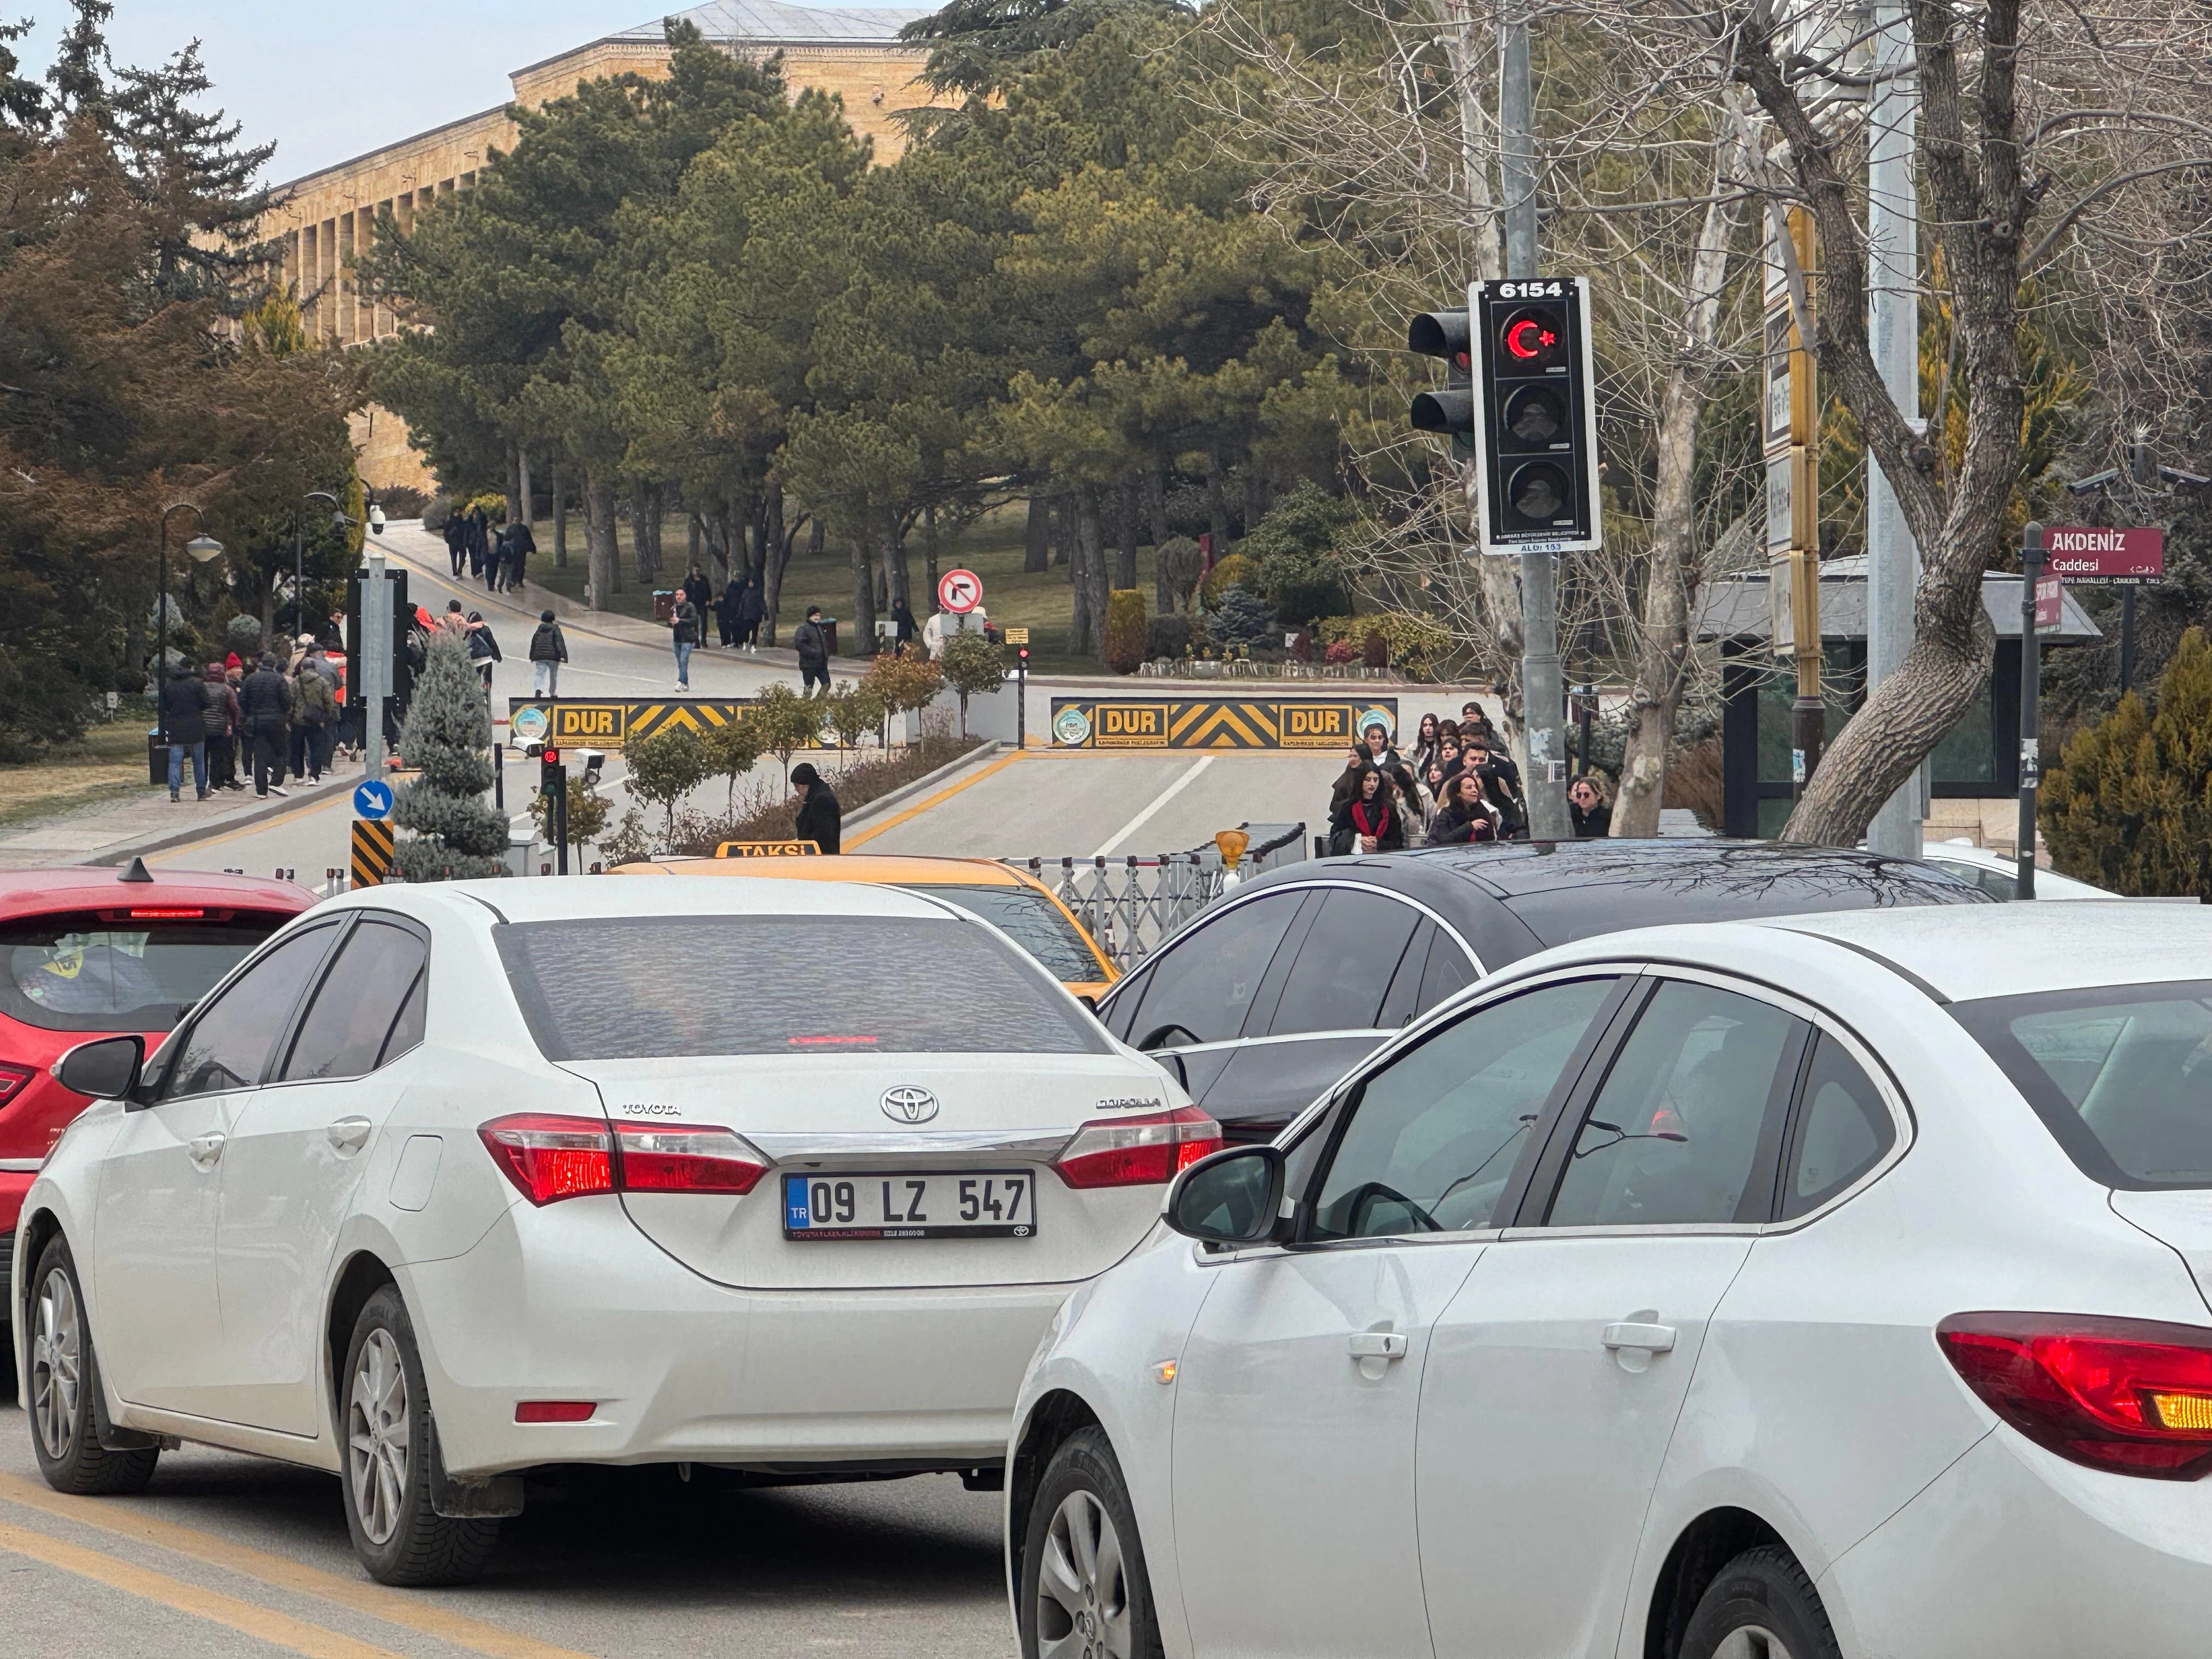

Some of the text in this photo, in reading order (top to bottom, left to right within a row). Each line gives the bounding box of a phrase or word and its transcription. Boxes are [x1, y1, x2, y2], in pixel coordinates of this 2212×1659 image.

[1500, 282, 1562, 298] 6154
[2052, 529, 2125, 551] AKDENİZ
[2053, 558, 2098, 571] Caddesi
[564, 712, 612, 733] DUR
[1107, 710, 1155, 733] DUR
[1291, 711, 1340, 733] DUR
[623, 1104, 681, 1116] TOYOTA
[811, 1180, 1024, 1223] 09 LZ 547
[791, 1207, 806, 1218] TR
